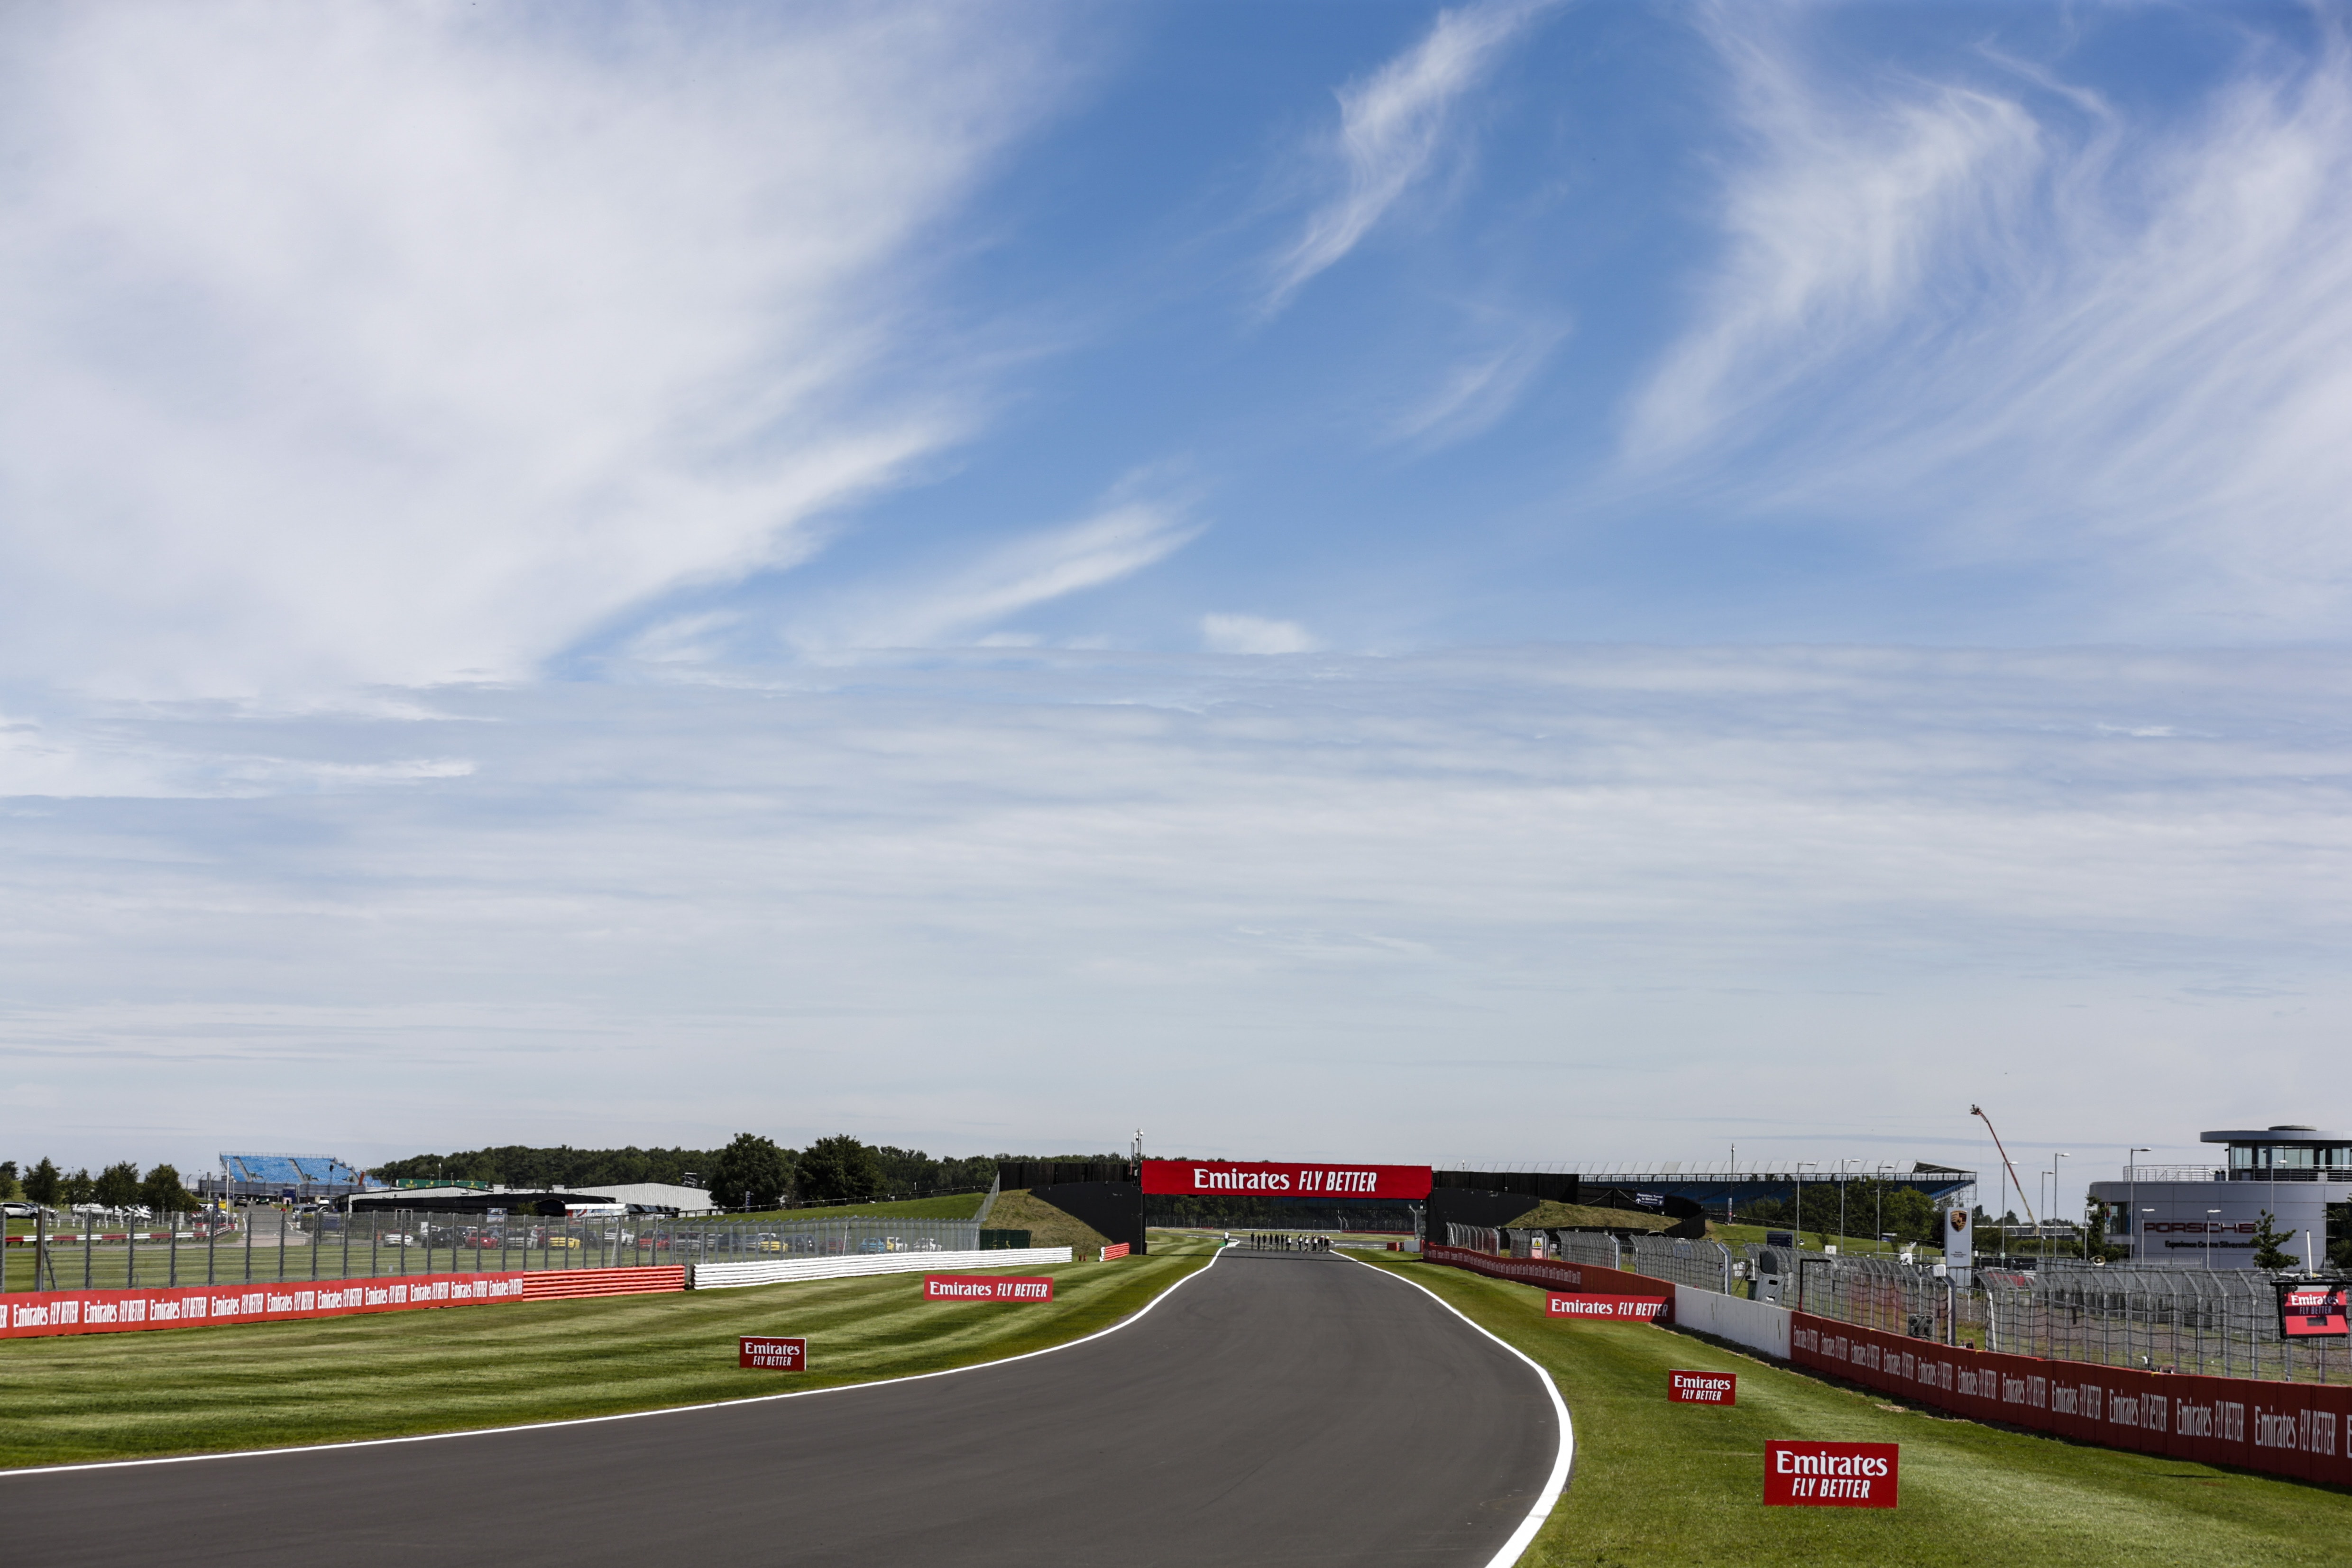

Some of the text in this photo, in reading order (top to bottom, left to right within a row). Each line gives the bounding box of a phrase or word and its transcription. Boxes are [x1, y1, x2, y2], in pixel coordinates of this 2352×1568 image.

[1194, 1168, 1377, 1192] Emirates FLY BETTER
[2143, 1222, 2257, 1233] PORSCHE
[2165, 1240, 2197, 1249] Experience
[365, 1286, 387, 1305] Emirates
[411, 1283, 432, 1302] Emirates
[489, 1280, 509, 1296] Emirates
[930, 1282, 1047, 1297] Emirates FLY BETTER
[150, 1299, 180, 1320] Emirates
[181, 1298, 190, 1318] FLY
[211, 1295, 239, 1316] Emirates
[267, 1292, 292, 1312] Emirates
[318, 1289, 342, 1309] Emirates
[1552, 1299, 1668, 1317] Emirates FLY BETTER
[2291, 1294, 2339, 1305] Emirates
[13, 1302, 48, 1327] Emirates
[50, 1302, 61, 1324] FLY
[84, 1300, 117, 1323] Emirates
[119, 1301, 129, 1322] FLY
[2311, 1306, 2332, 1314] BETTER
[745, 1342, 799, 1355] Emirates
[753, 1356, 791, 1366] FLY BETTER
[1884, 1348, 1901, 1375] Emirates
[1918, 1357, 1936, 1385] Emirates
[1675, 1375, 1730, 1390] Emirates
[1958, 1365, 1977, 1395] Emirates
[1682, 1390, 1721, 1401] FLY BETTER
[2003, 1372, 2024, 1404] Emirates
[2032, 1376, 2046, 1409] BETTER
[2052, 1380, 2077, 1414] Emirates
[2086, 1385, 2101, 1420] BETTER
[2109, 1388, 2167, 1432] Emirates FLY BETTER
[2177, 1397, 2244, 1442] Emirates FLY BETTER
[2255, 1405, 2296, 1449] Emirates
[2299, 1409, 2311, 1451] FLY
[2312, 1410, 2336, 1456] BETTER
[1776, 1451, 1887, 1476] Emirates
[1792, 1478, 1870, 1498] FLY BETTER
